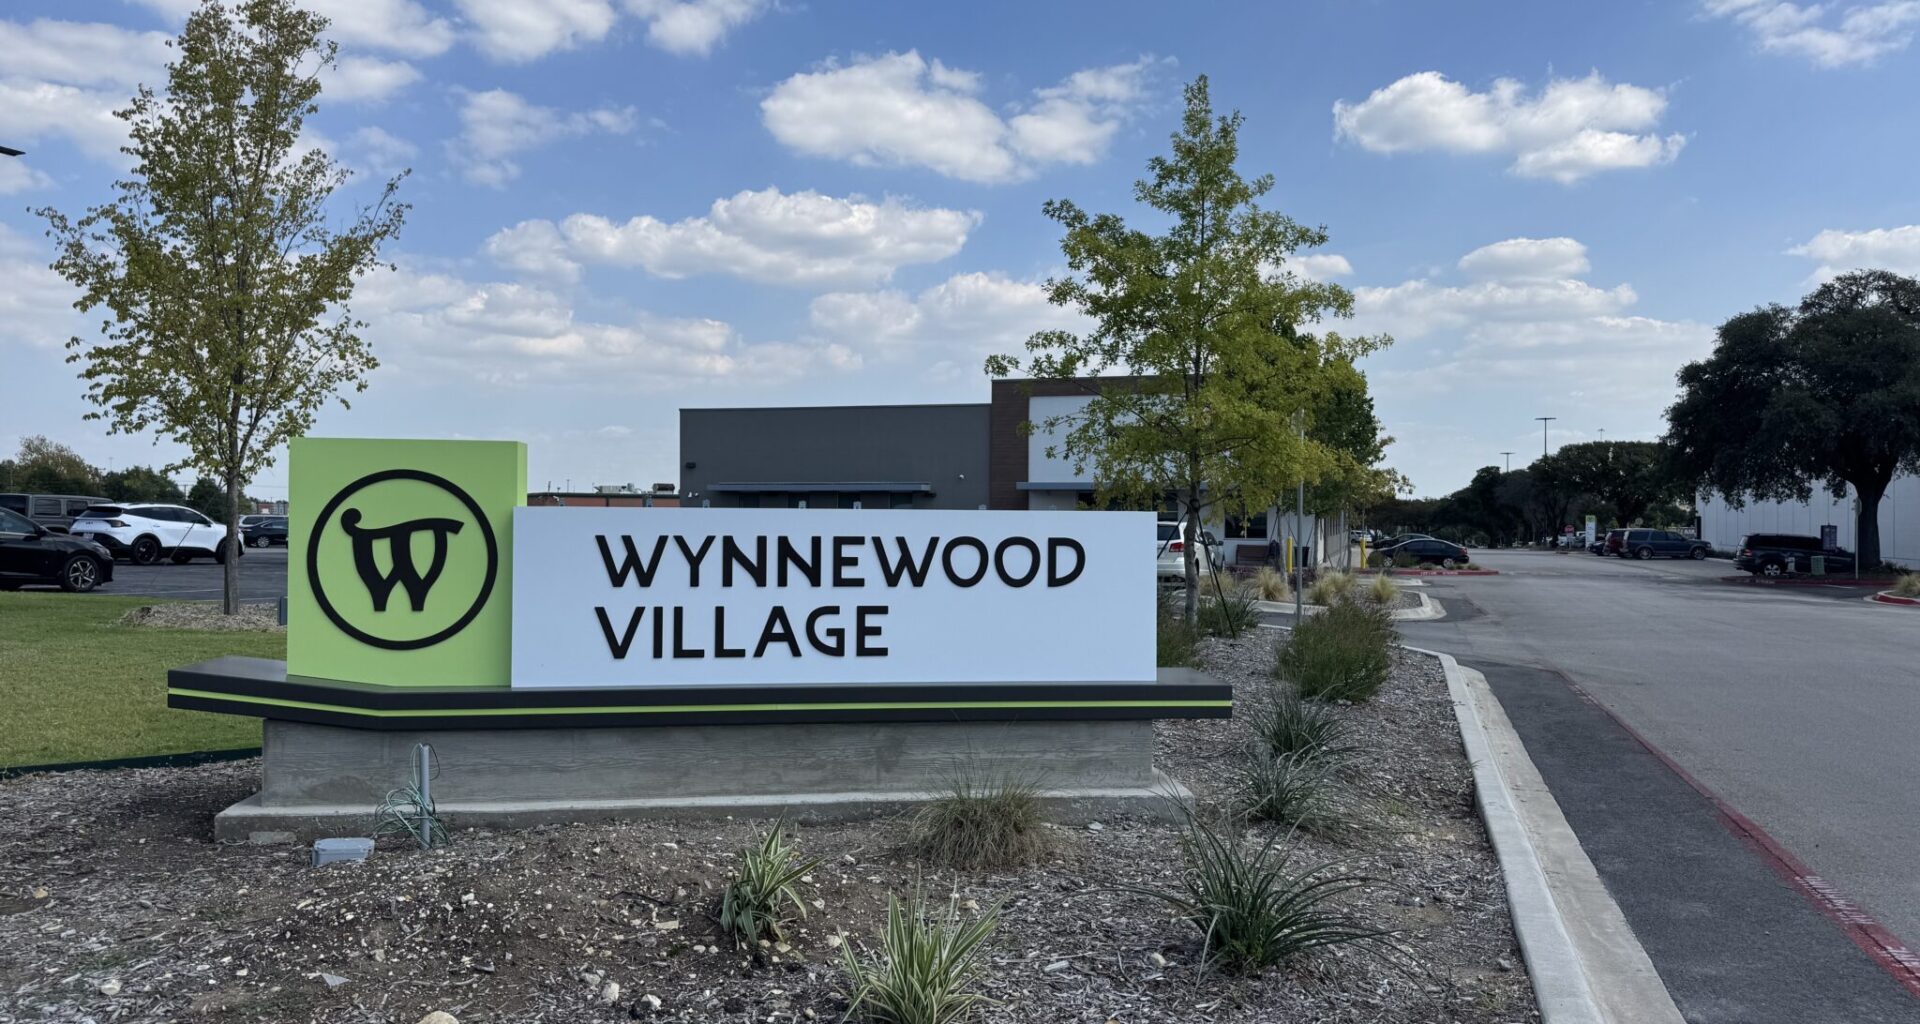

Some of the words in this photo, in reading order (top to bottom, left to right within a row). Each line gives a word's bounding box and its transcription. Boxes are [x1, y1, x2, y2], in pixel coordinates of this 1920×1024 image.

[341, 508, 465, 612] W
[595, 535, 1086, 588] WYNNEWOOD
[595, 606, 889, 659] VILLAGE
